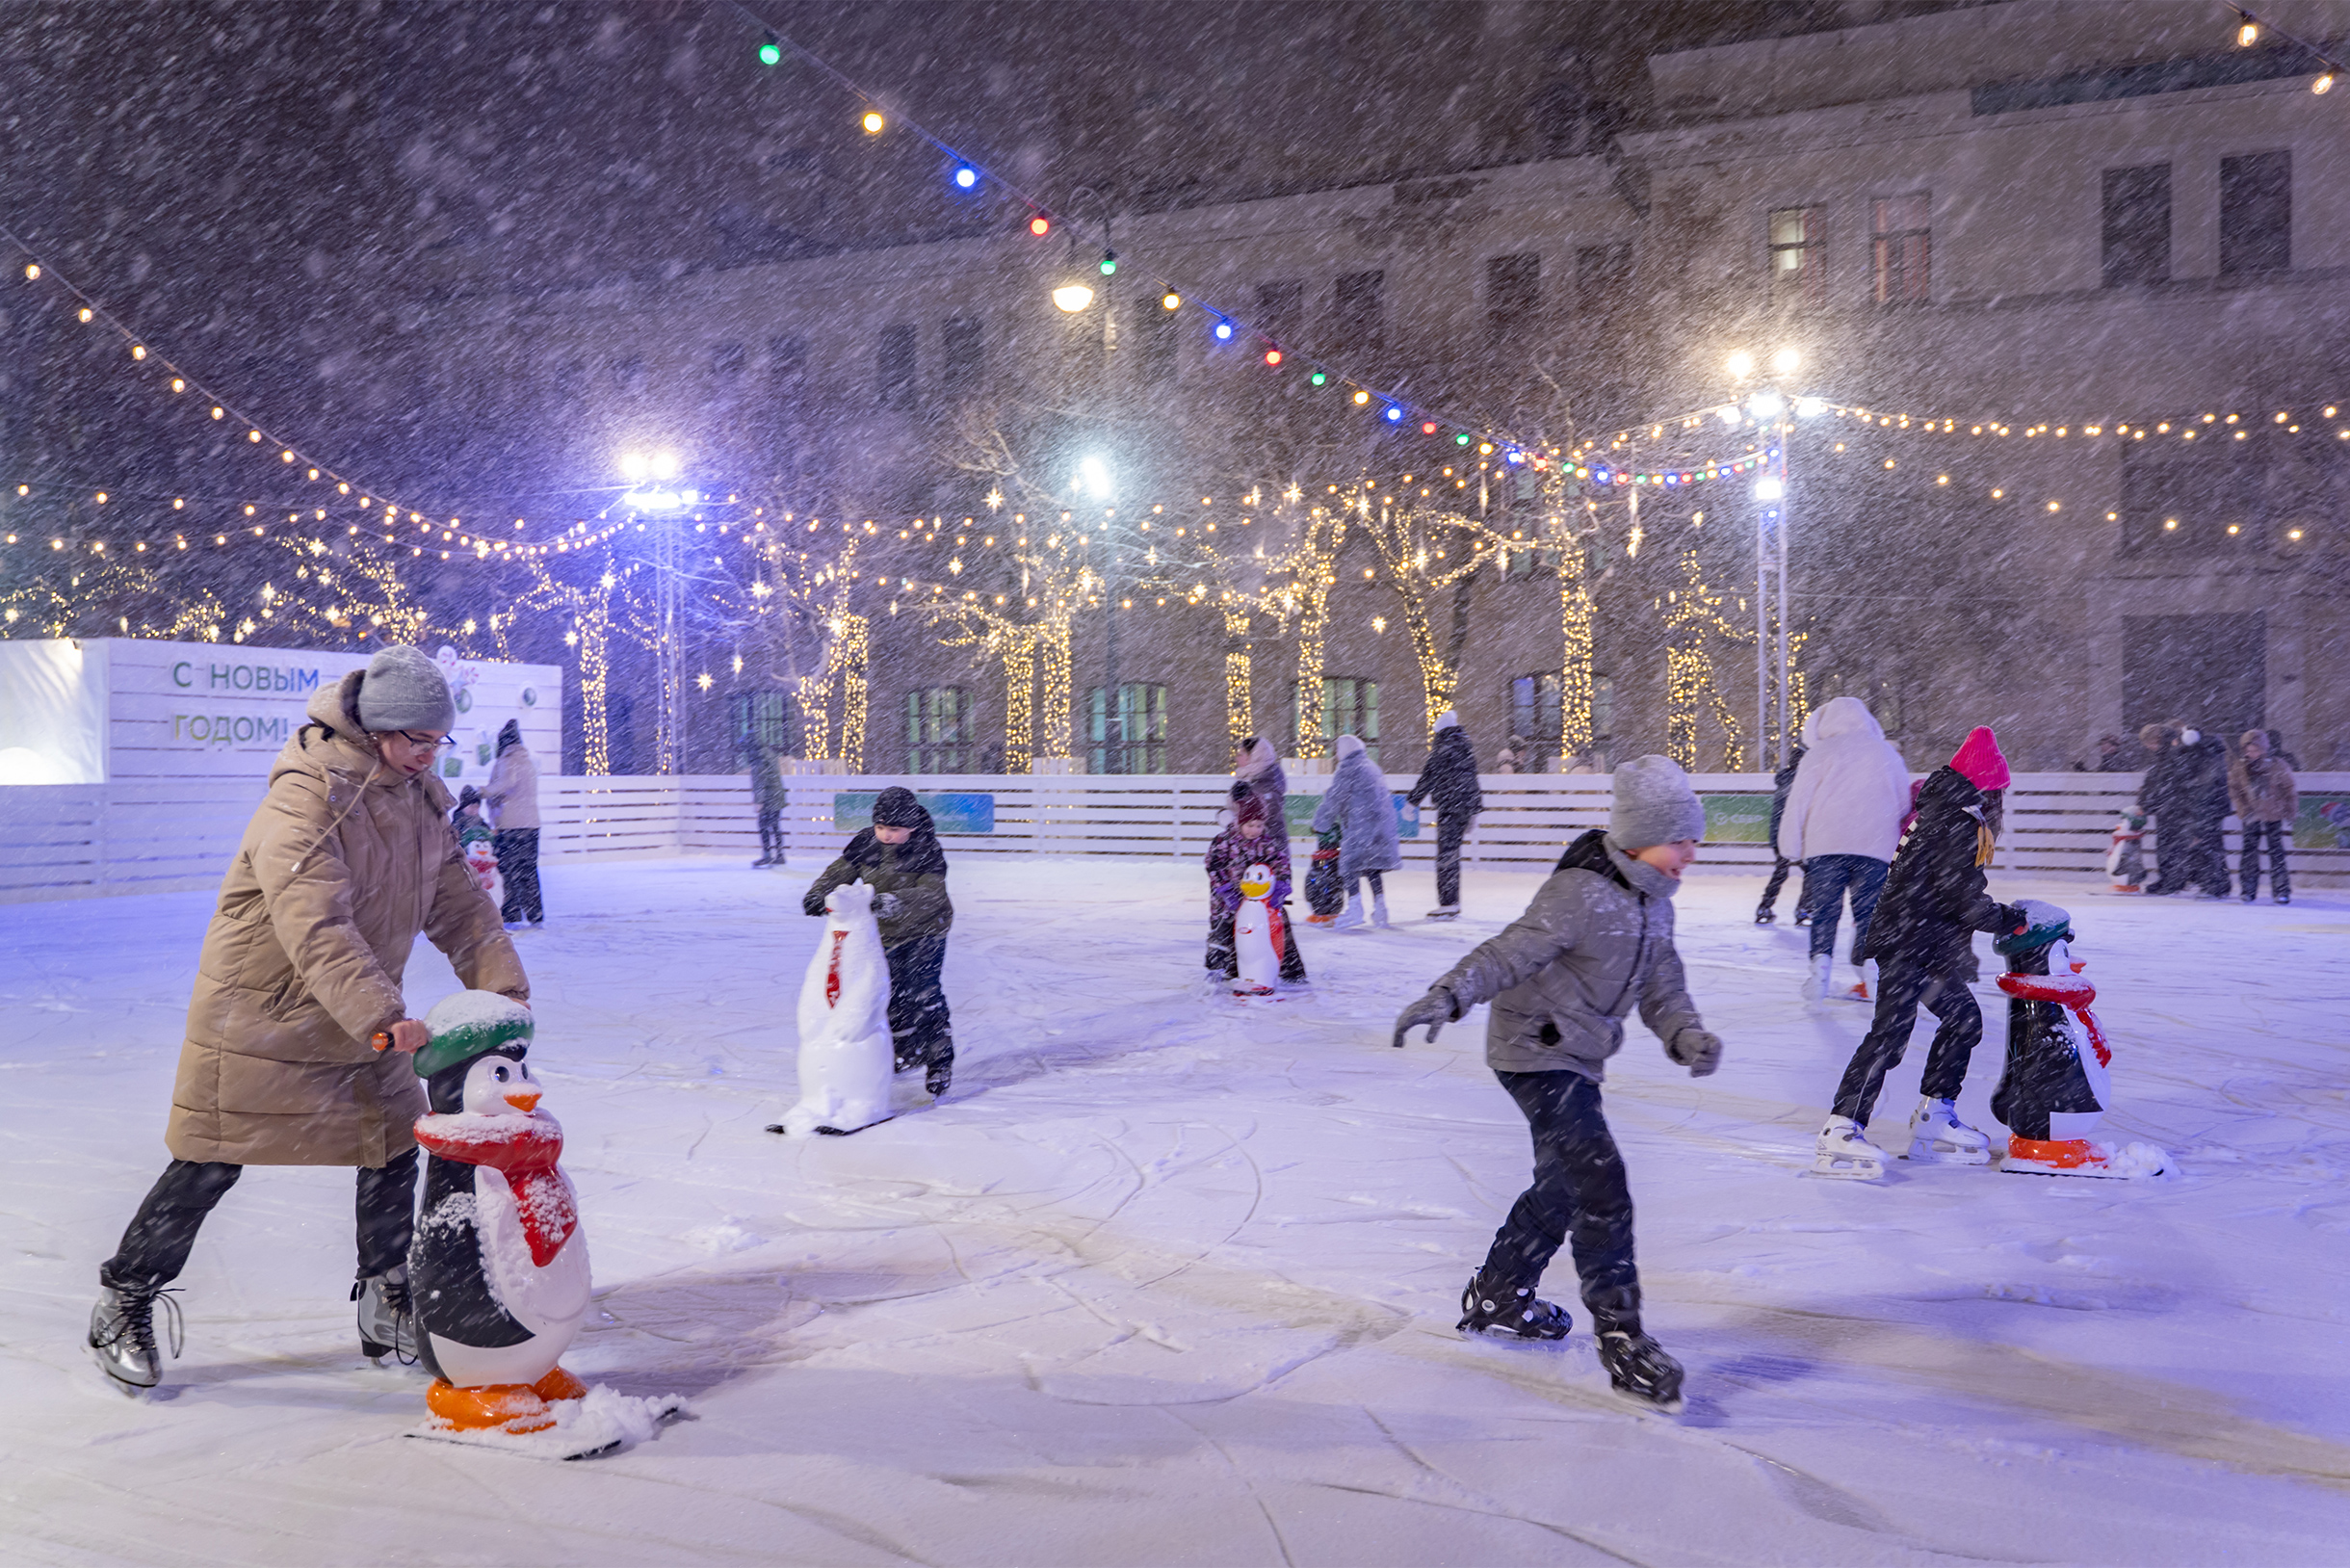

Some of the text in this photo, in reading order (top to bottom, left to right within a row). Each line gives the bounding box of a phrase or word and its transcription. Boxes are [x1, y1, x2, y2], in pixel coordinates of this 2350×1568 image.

[173, 662, 319, 692] С НОВЫМ
[175, 716, 289, 745] ГОДОМ!
